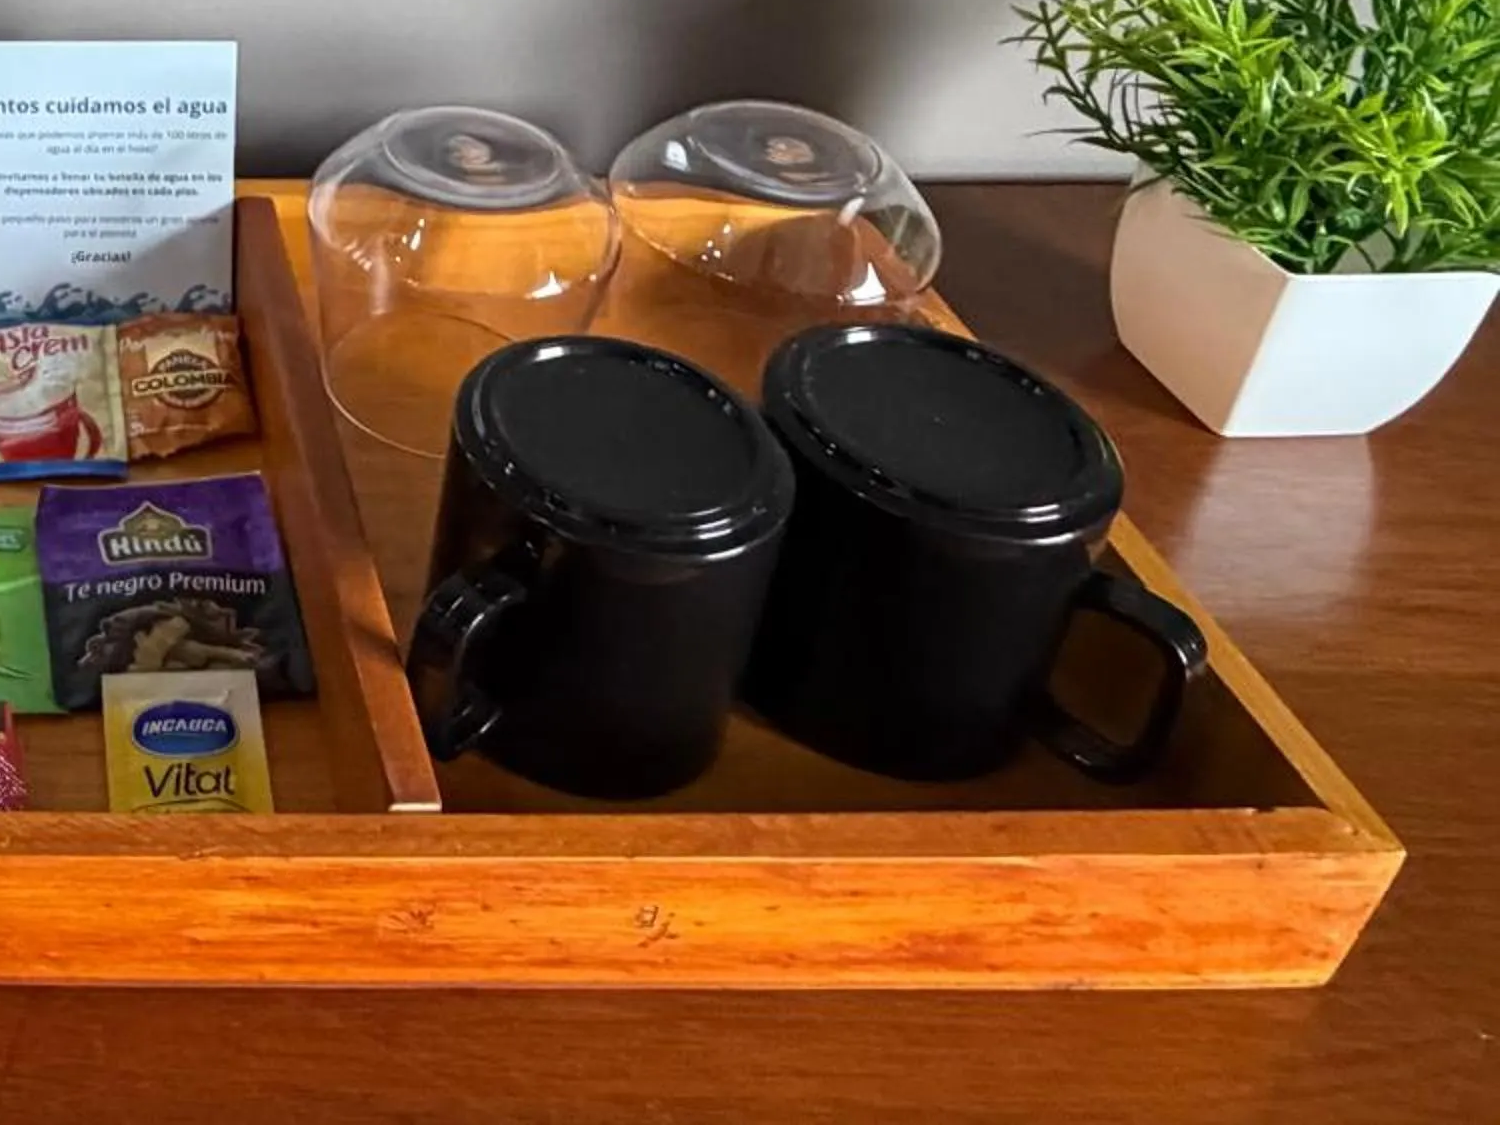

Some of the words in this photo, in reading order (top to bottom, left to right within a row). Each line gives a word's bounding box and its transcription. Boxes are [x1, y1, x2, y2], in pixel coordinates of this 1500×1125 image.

[45, 96, 147, 114] cuidamos
[153, 96, 171, 114] el
[177, 100, 228, 119] agua
[109, 533, 204, 558] Hindú
[96, 575, 162, 596] negro
[168, 571, 266, 595] Premium
[141, 718, 227, 736] INCAUCA
[143, 762, 235, 798] Vital
